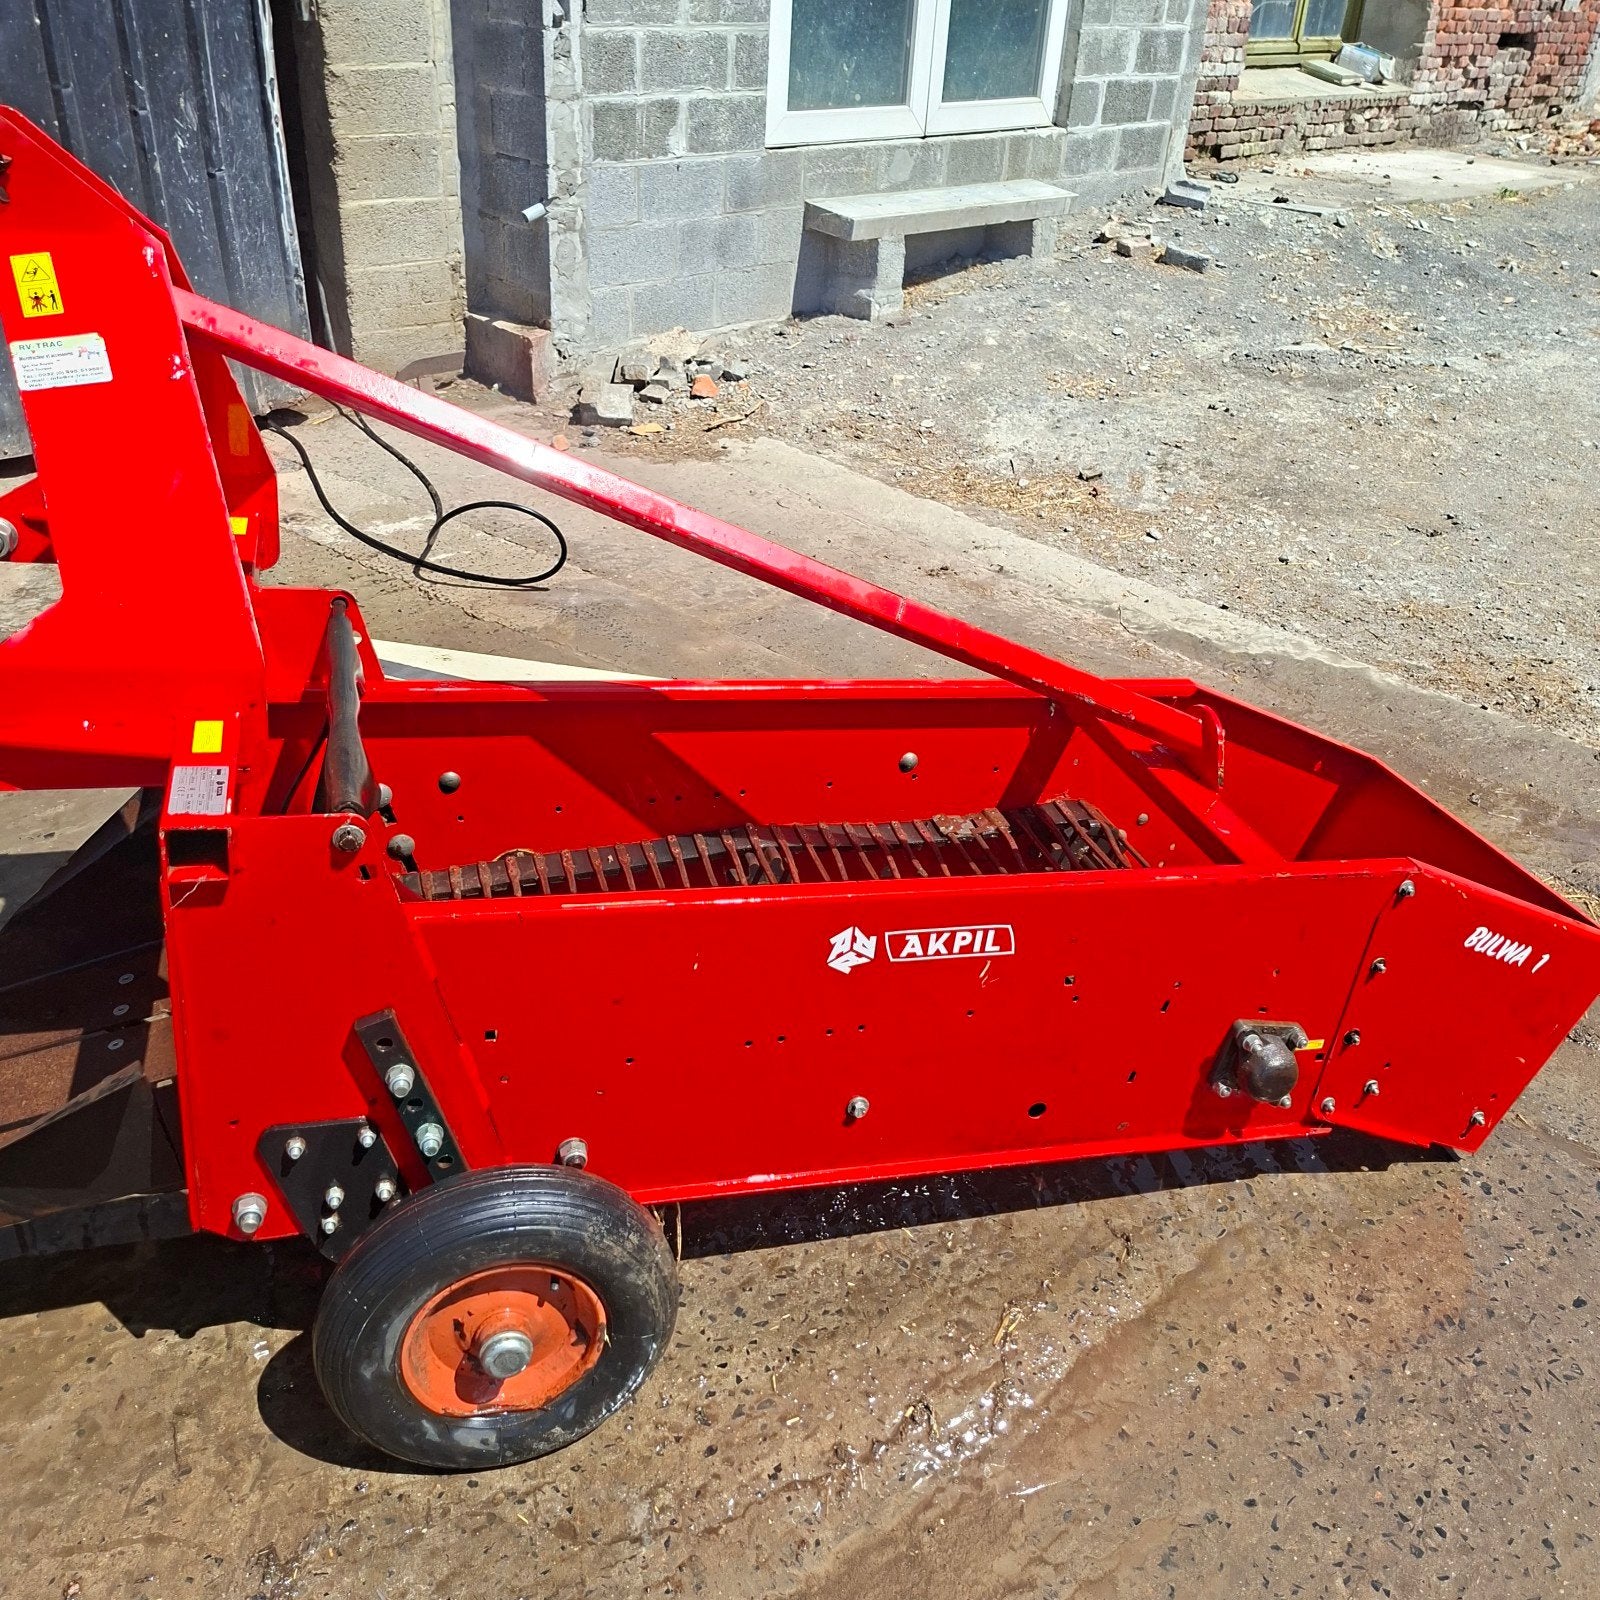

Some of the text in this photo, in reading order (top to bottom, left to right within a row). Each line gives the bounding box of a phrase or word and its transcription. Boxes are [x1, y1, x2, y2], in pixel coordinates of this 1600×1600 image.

[899, 929, 1001, 958] AKPIL
[1464, 926, 1550, 974] BULWA 1
